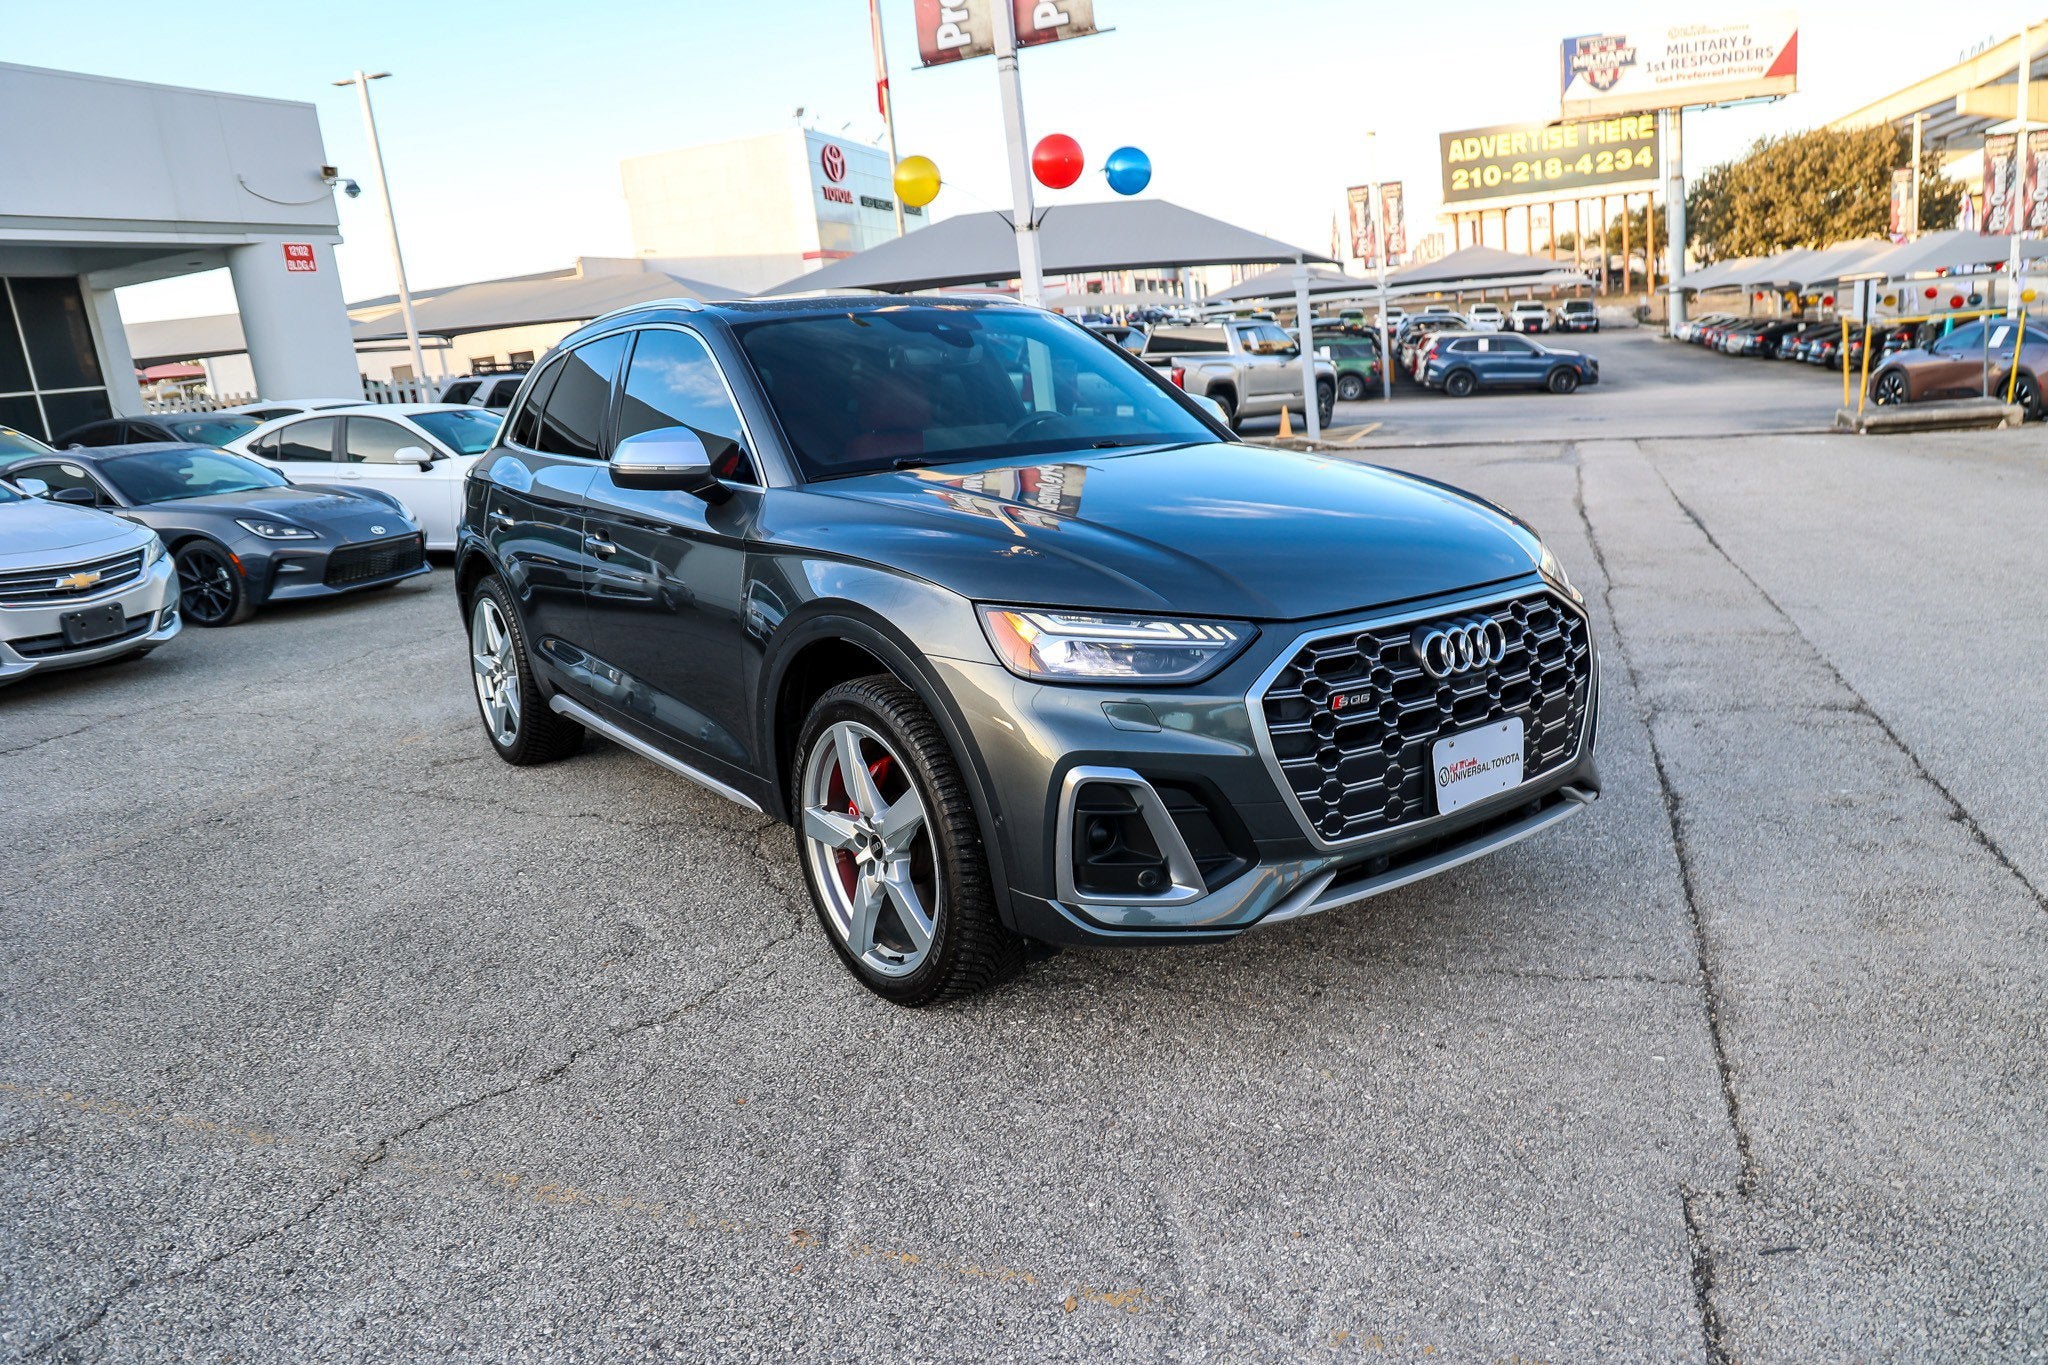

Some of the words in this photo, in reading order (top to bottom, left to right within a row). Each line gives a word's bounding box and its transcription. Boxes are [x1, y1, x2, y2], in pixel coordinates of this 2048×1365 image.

[1666, 36, 1738, 56] MILITARY
[1572, 48, 1636, 69] MILITARY
[1646, 61, 1666, 73] 1st
[1671, 46, 1774, 70] RESPONDERS
[1676, 67, 1725, 81] Preferred
[1727, 64, 1764, 75] Pricing
[1448, 124, 1579, 163] ADVERTISE
[1587, 114, 1655, 145] HERE
[1451, 146, 1654, 191] 210-218-4234
[822, 185, 853, 204] TOYOTA
[1450, 761, 1491, 784] UNIVERSAL
[1491, 752, 1520, 769] TOYOTA
